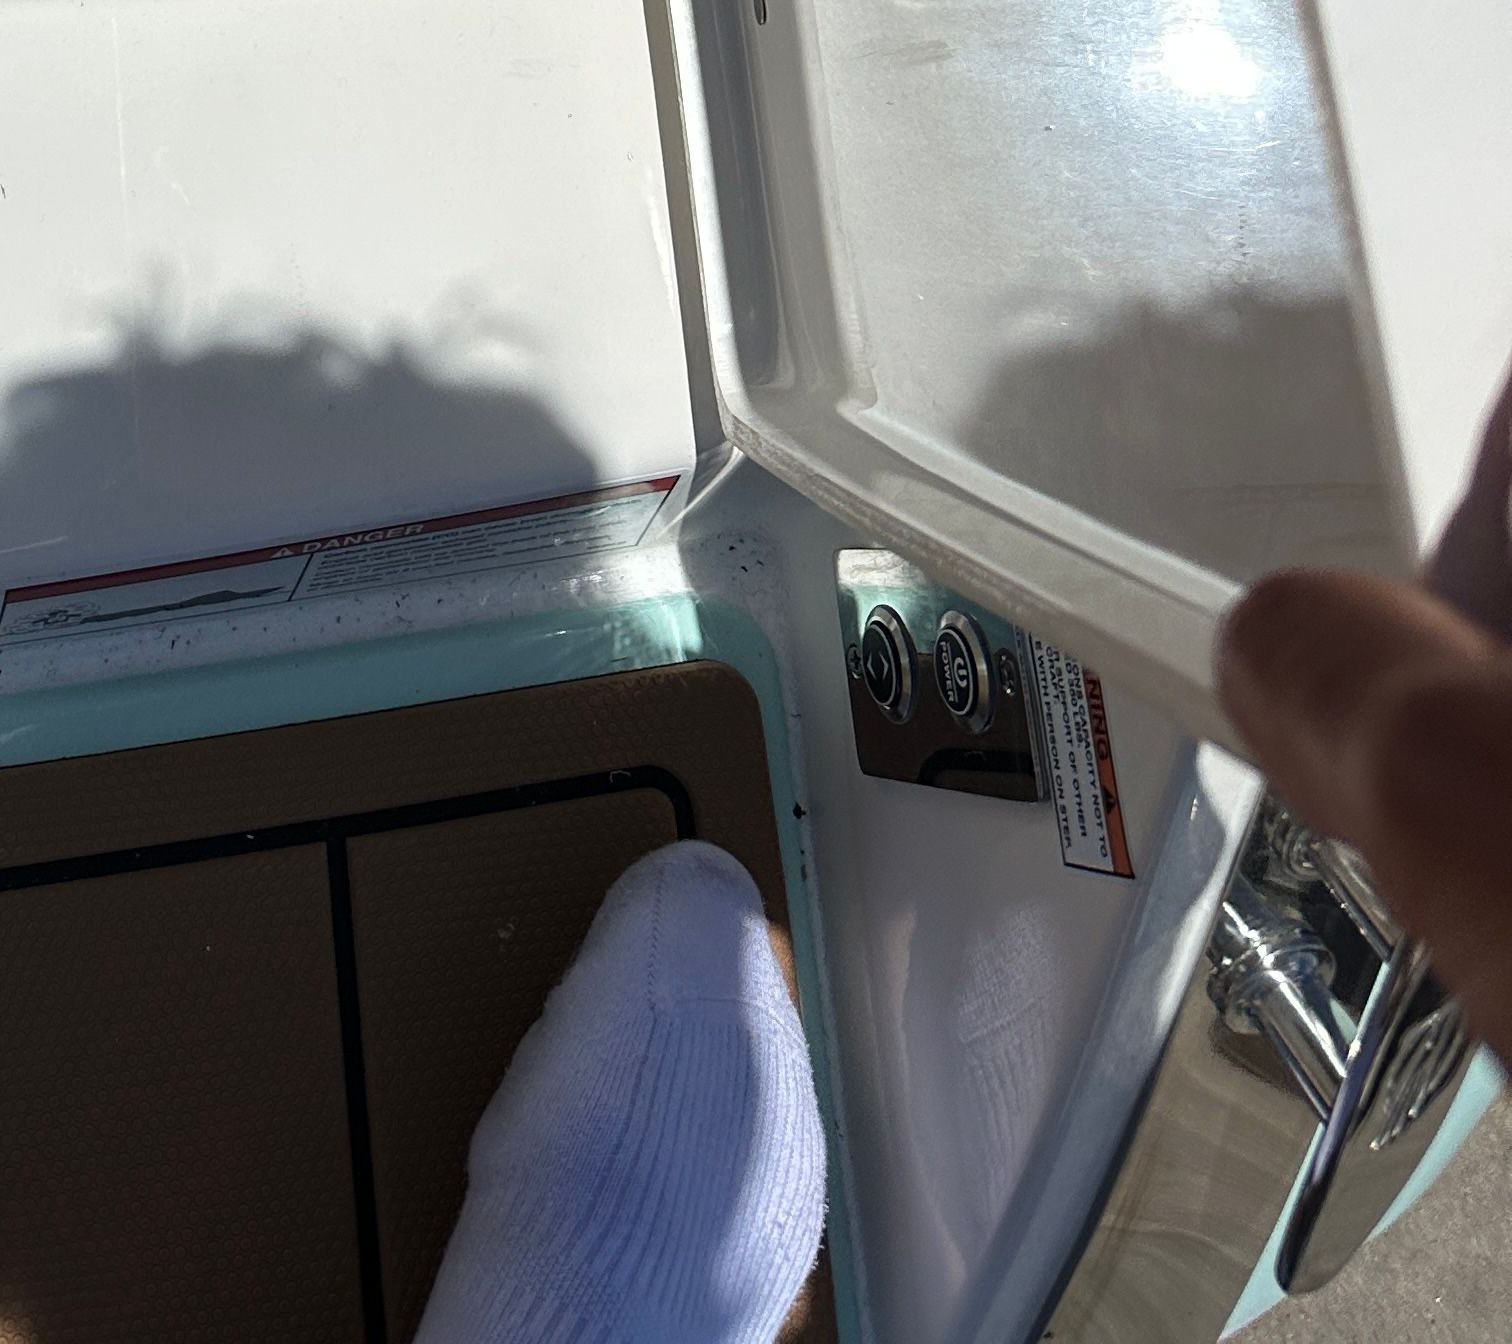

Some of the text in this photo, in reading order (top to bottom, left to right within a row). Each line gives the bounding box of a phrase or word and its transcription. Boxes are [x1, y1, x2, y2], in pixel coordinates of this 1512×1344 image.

[302, 523, 424, 554] DANGER
[939, 641, 955, 702] POWER
[1055, 666, 1073, 747] SUPPORT
[1037, 655, 1049, 697] WITH
[1045, 701, 1061, 770] PERSON
[1055, 775, 1065, 800] ON
[1088, 679, 1109, 761] NING
[1068, 751, 1078, 772] OF
[1078, 704, 1097, 789] CAPACITY
[1092, 794, 1104, 830] NOT
[1099, 835, 1108, 858] TO
[1072, 778, 1087, 837] OTHER
